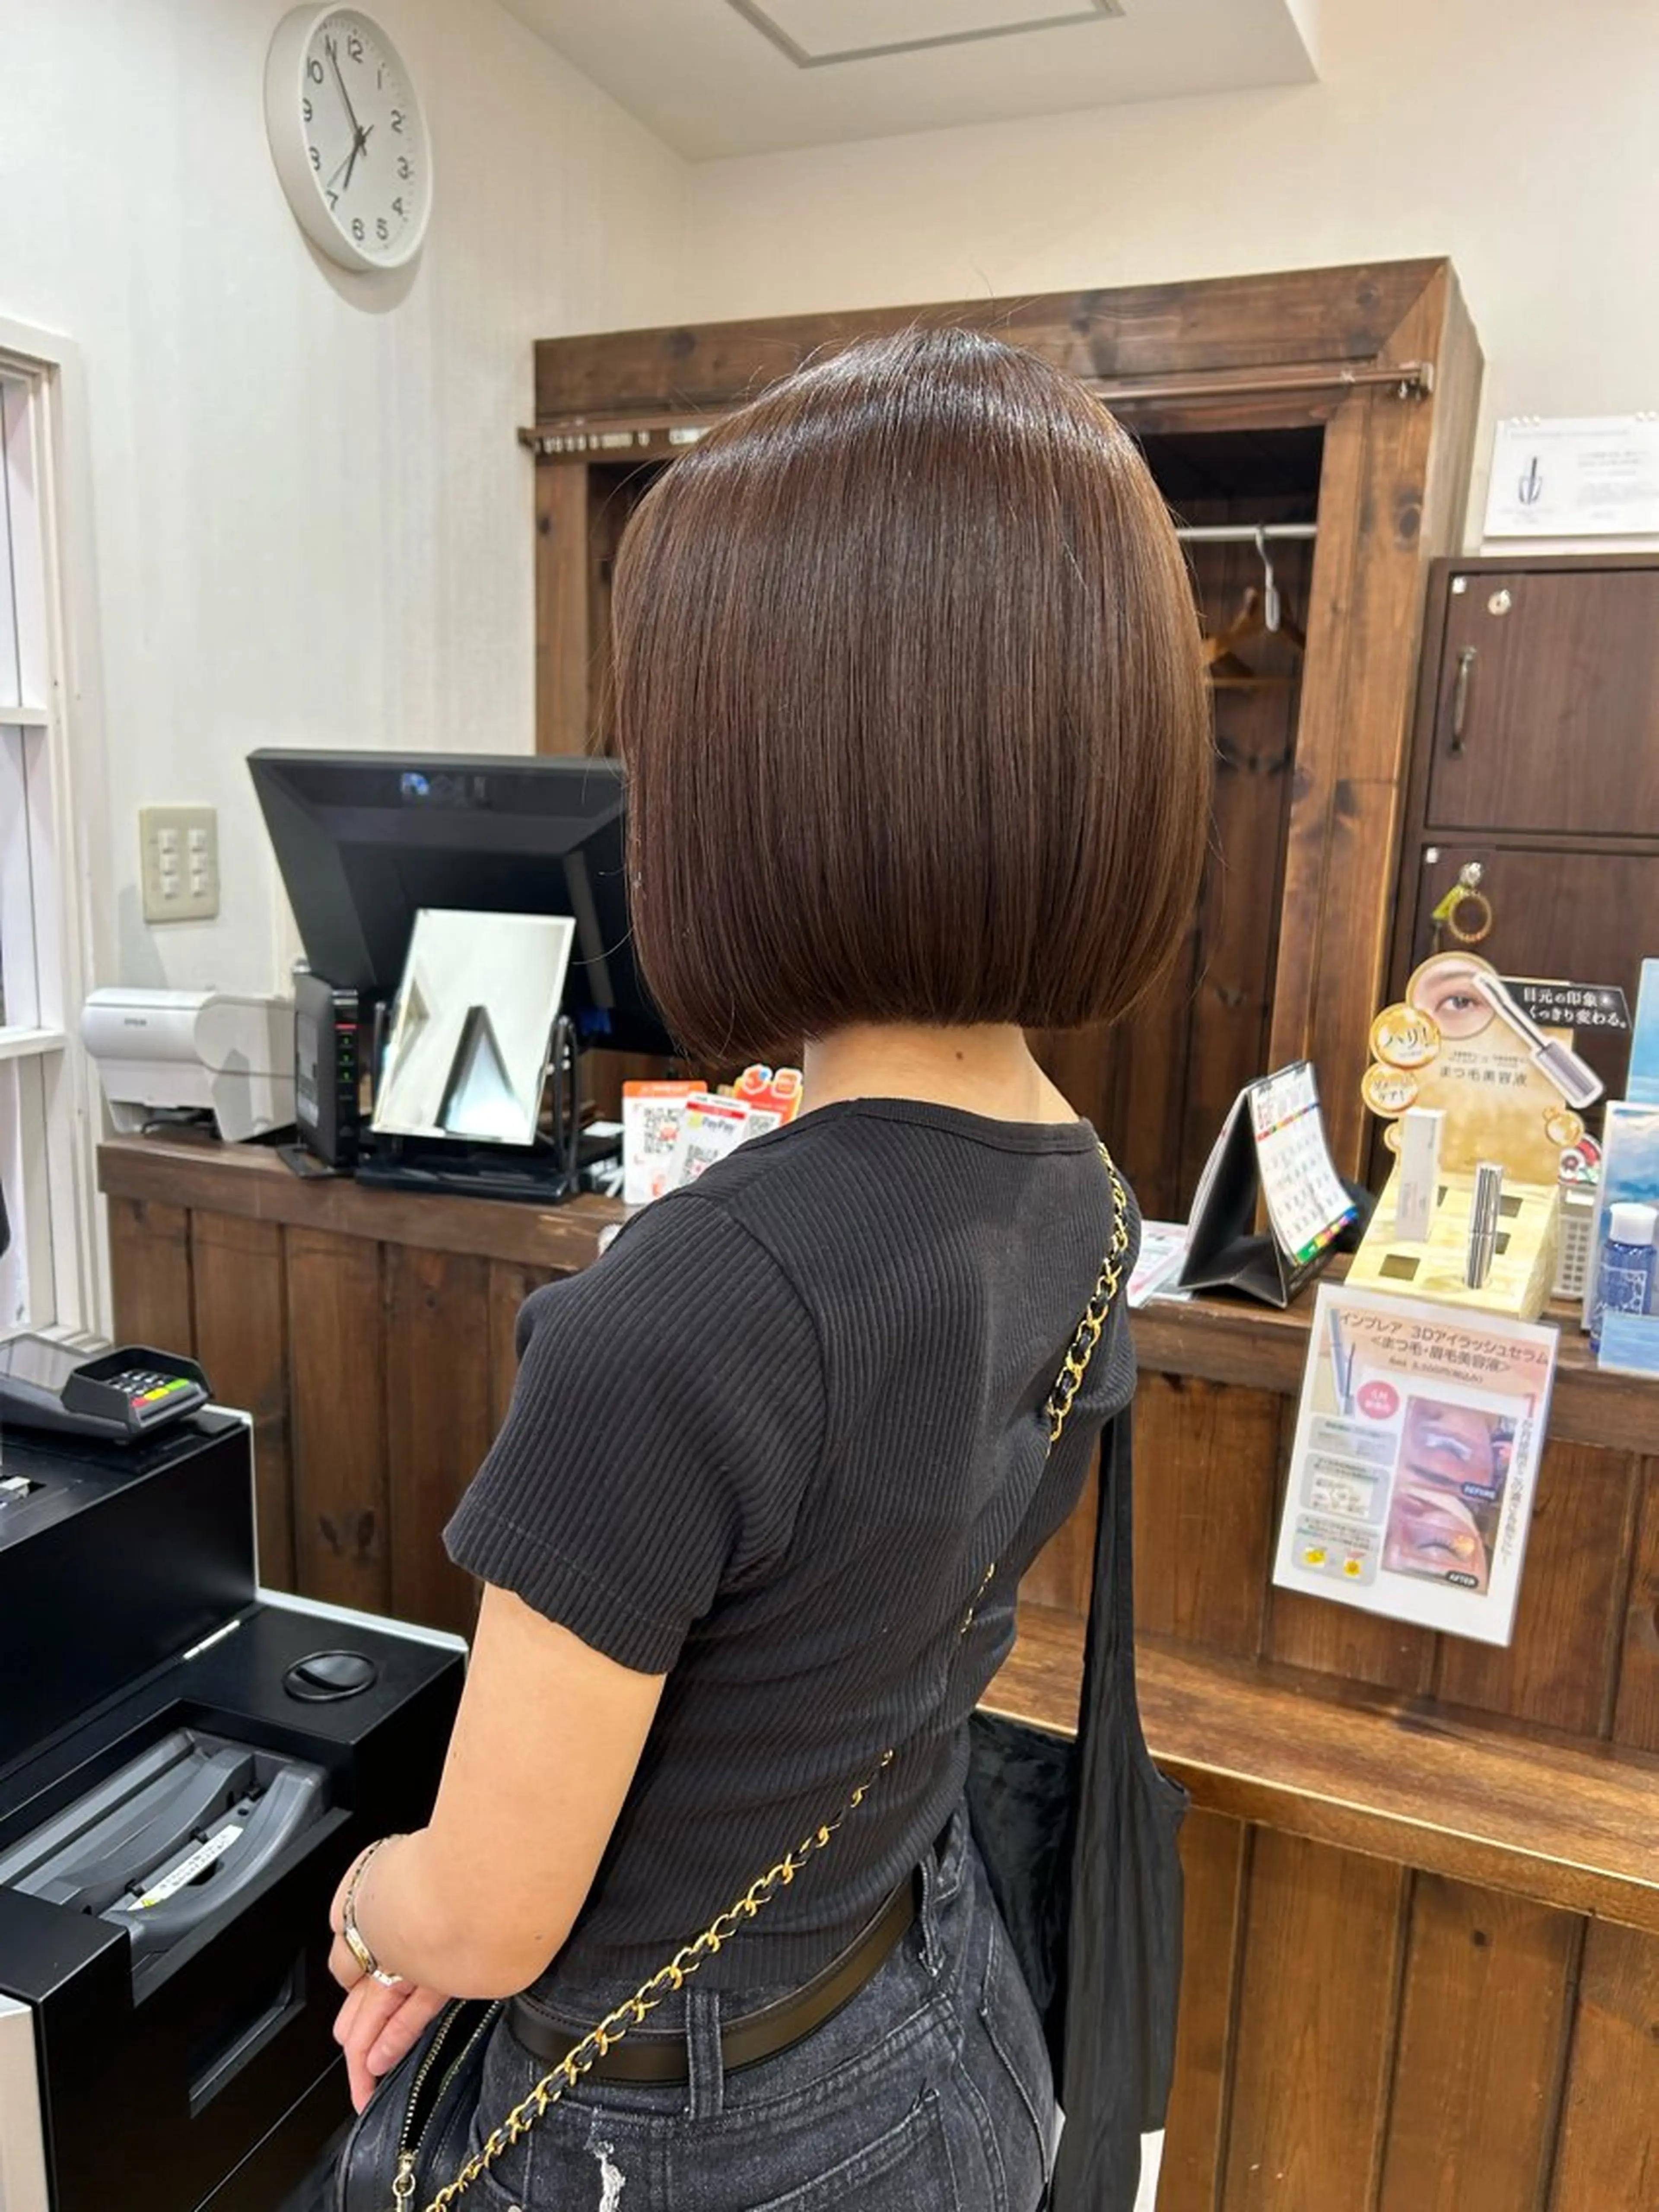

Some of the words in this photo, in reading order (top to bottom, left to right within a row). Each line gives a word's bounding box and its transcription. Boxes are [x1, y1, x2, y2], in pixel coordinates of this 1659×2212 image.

[347, 34, 364, 64] 12
[306, 55, 324, 84] 10
[377, 70, 382, 89] 1
[302, 97, 313, 123] 9
[391, 110, 402, 133] 2
[397, 156, 409, 180] 3
[326, 189, 339, 211] 7
[391, 196, 404, 216] 4
[352, 217, 365, 242] 6
[376, 217, 389, 241] 5
[1523, 987, 1598, 1007] 目元の印象
[1440, 1067, 1528, 1088] まつ毛美容液
